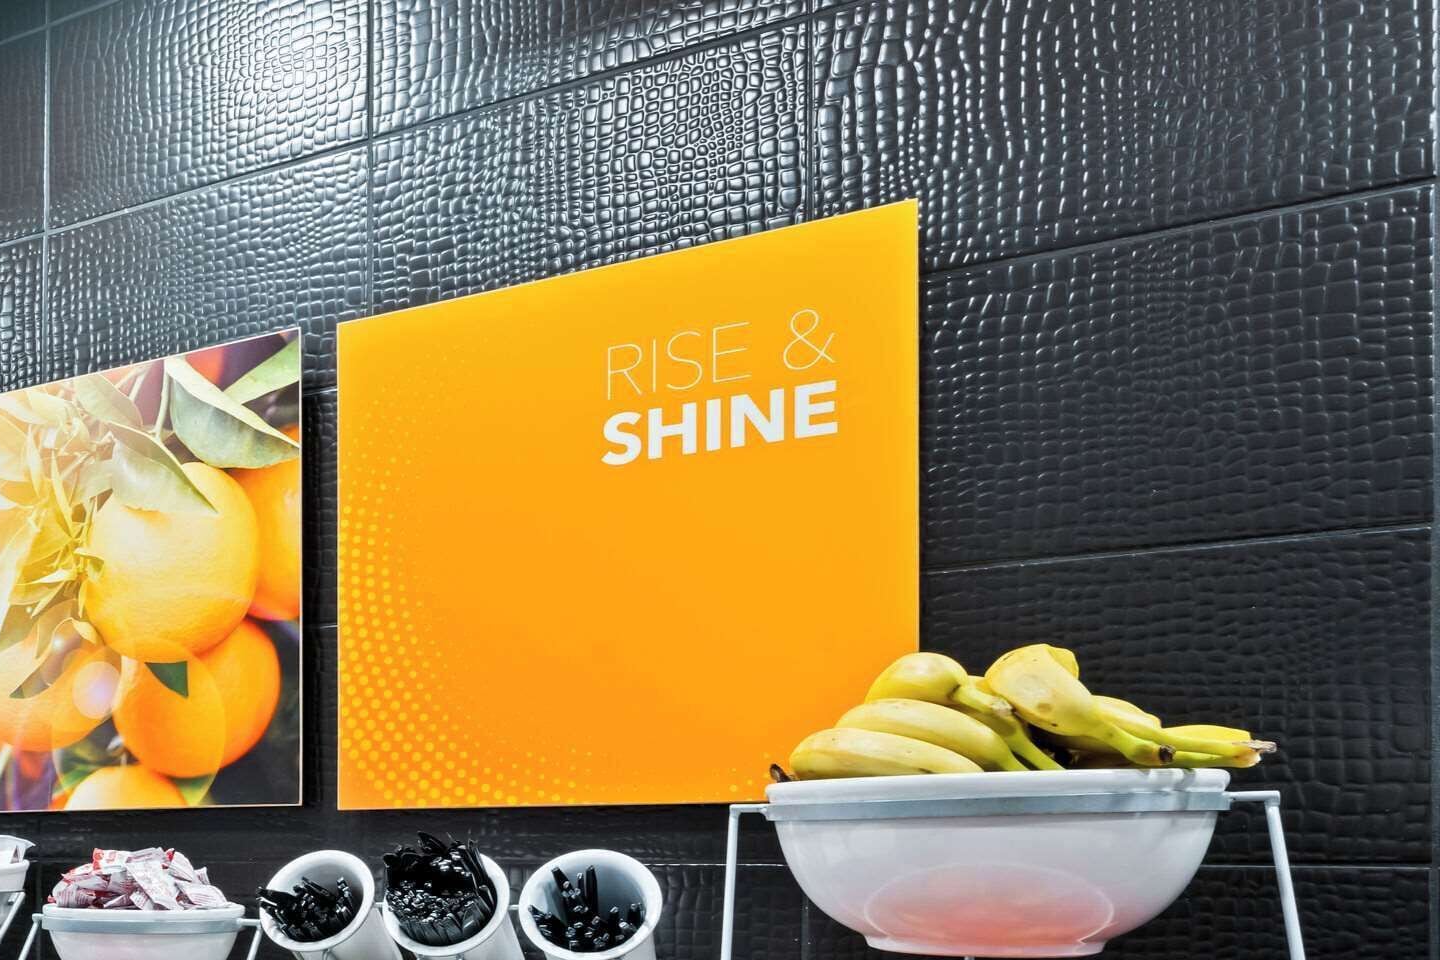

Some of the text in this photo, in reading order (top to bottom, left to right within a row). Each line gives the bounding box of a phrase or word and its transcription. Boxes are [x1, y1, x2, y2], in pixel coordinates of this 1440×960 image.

[607, 308, 836, 400] RISE &
[601, 379, 839, 466] SHINE
